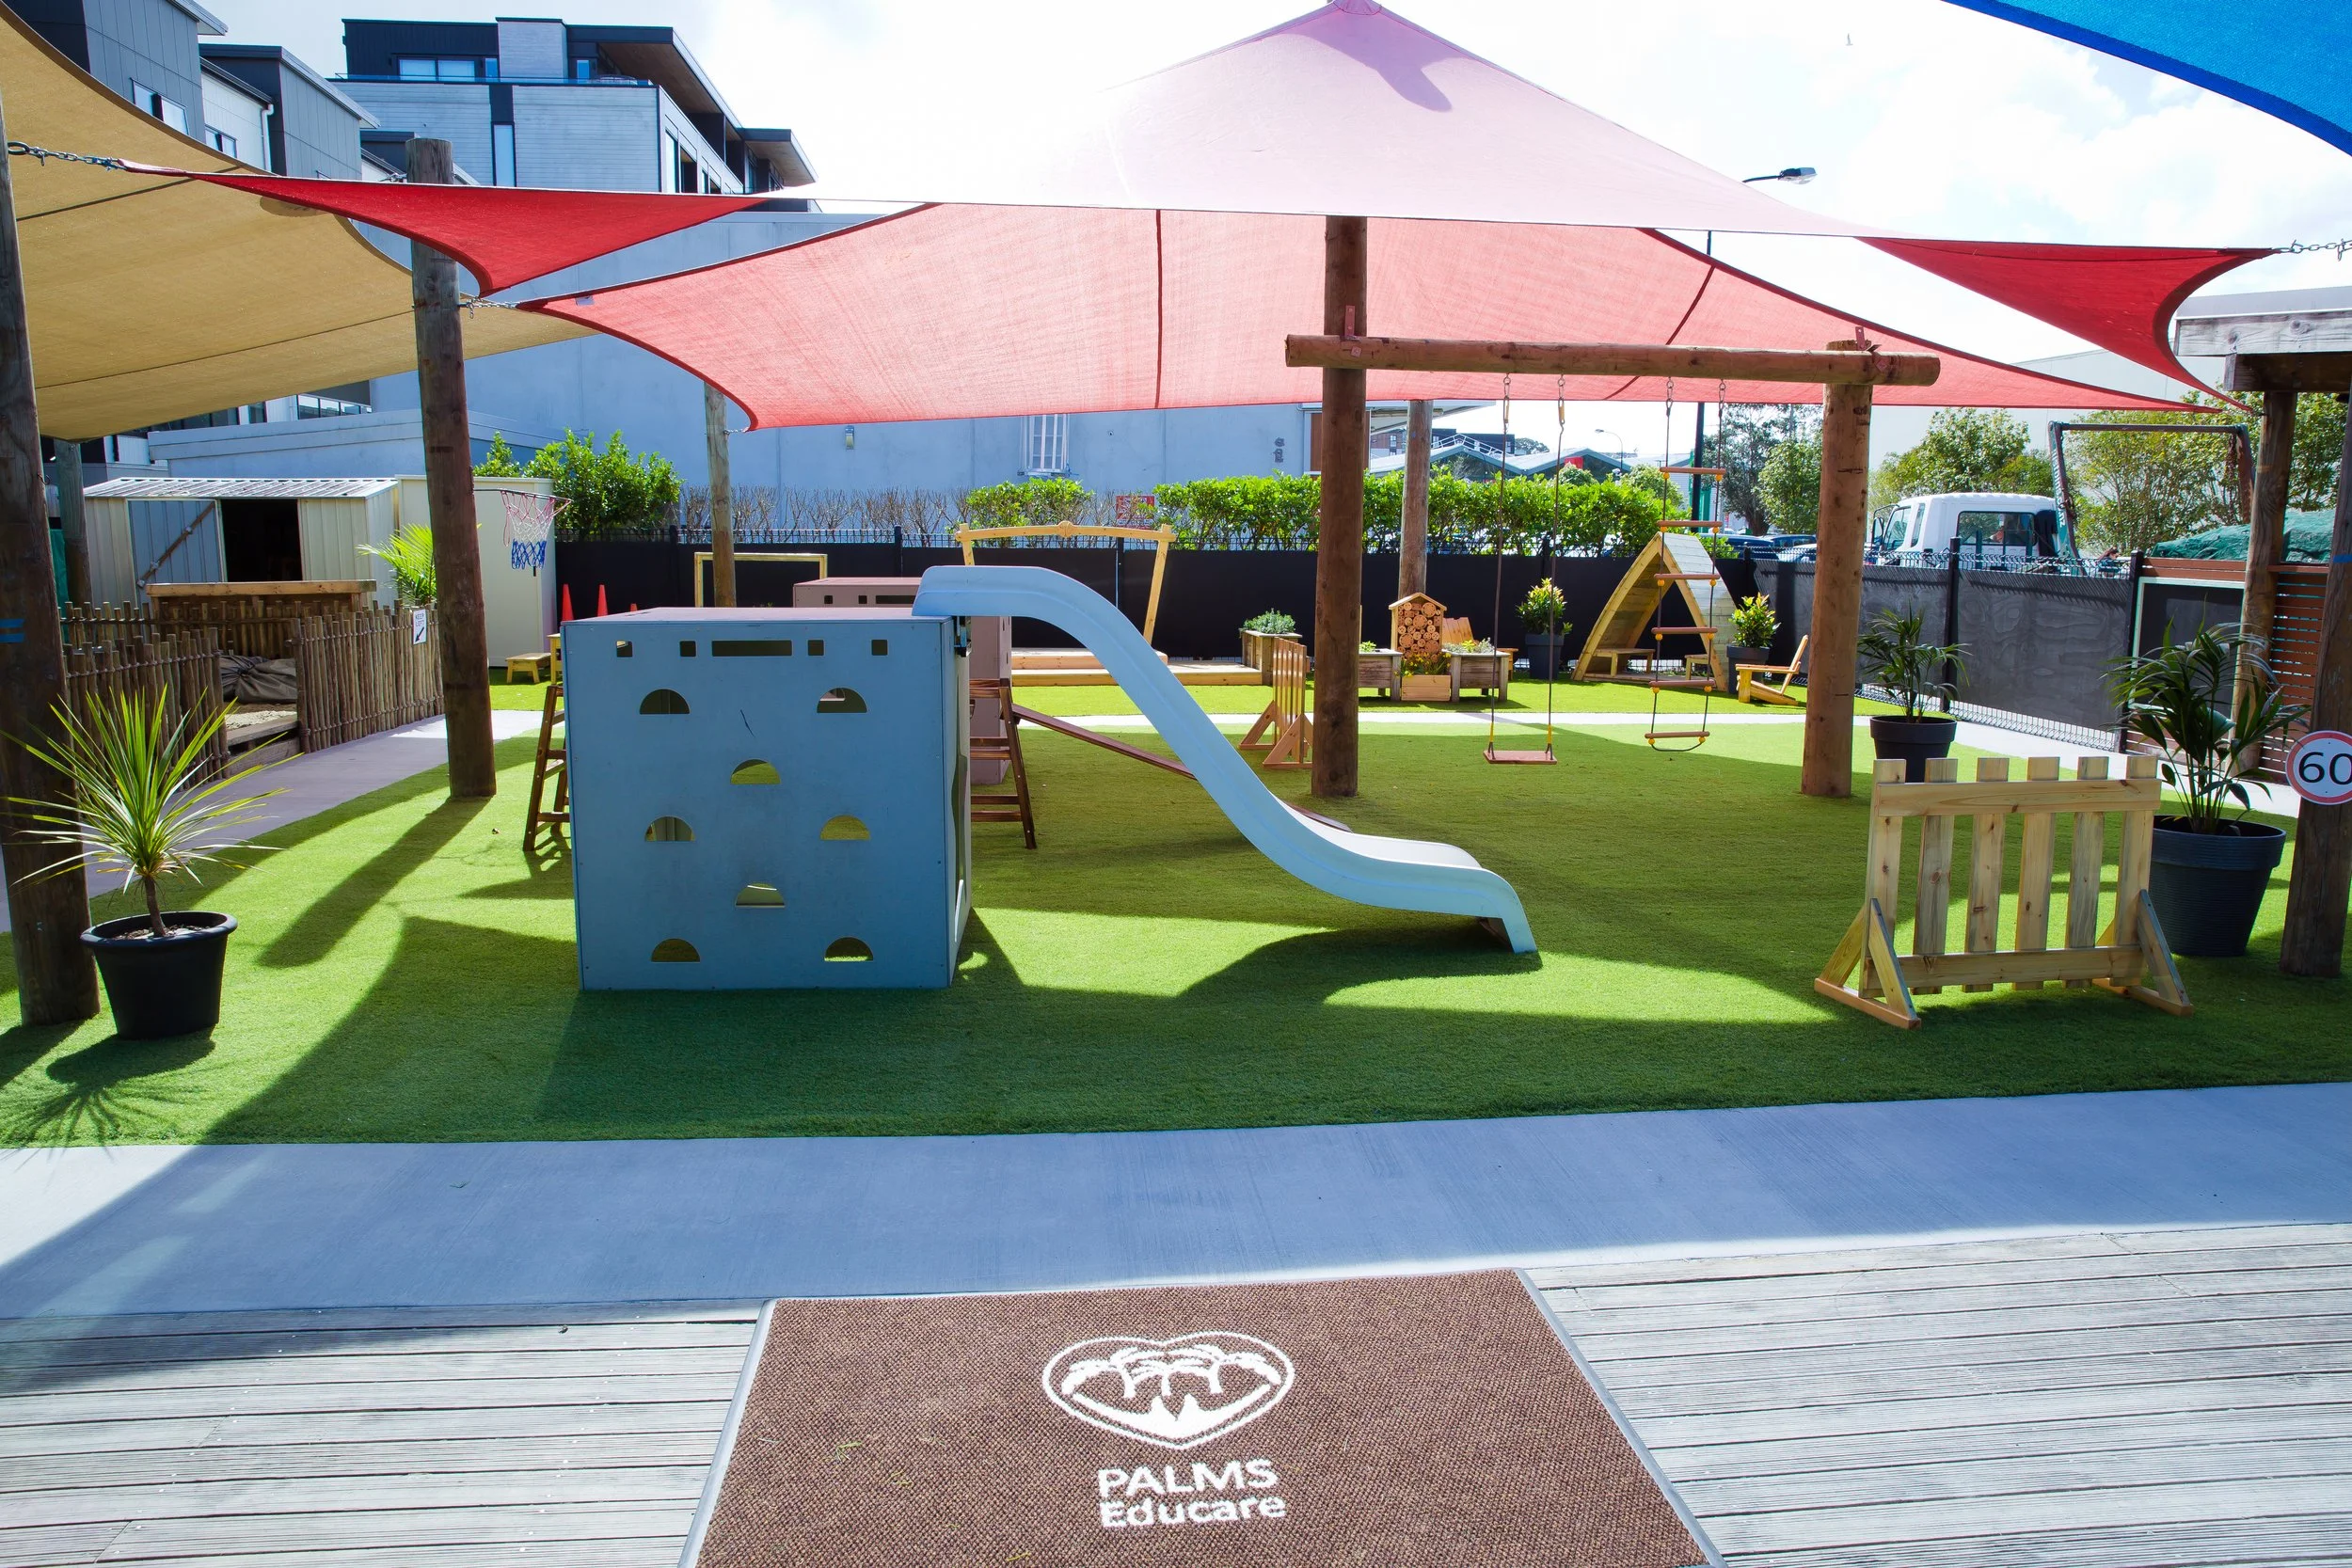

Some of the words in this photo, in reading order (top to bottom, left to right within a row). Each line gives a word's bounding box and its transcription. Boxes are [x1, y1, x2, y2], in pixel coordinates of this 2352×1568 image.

[2298, 752, 2352, 785] 60
[1097, 1459, 1279, 1497] PALMS
[1099, 1497, 1287, 1528] Educare
